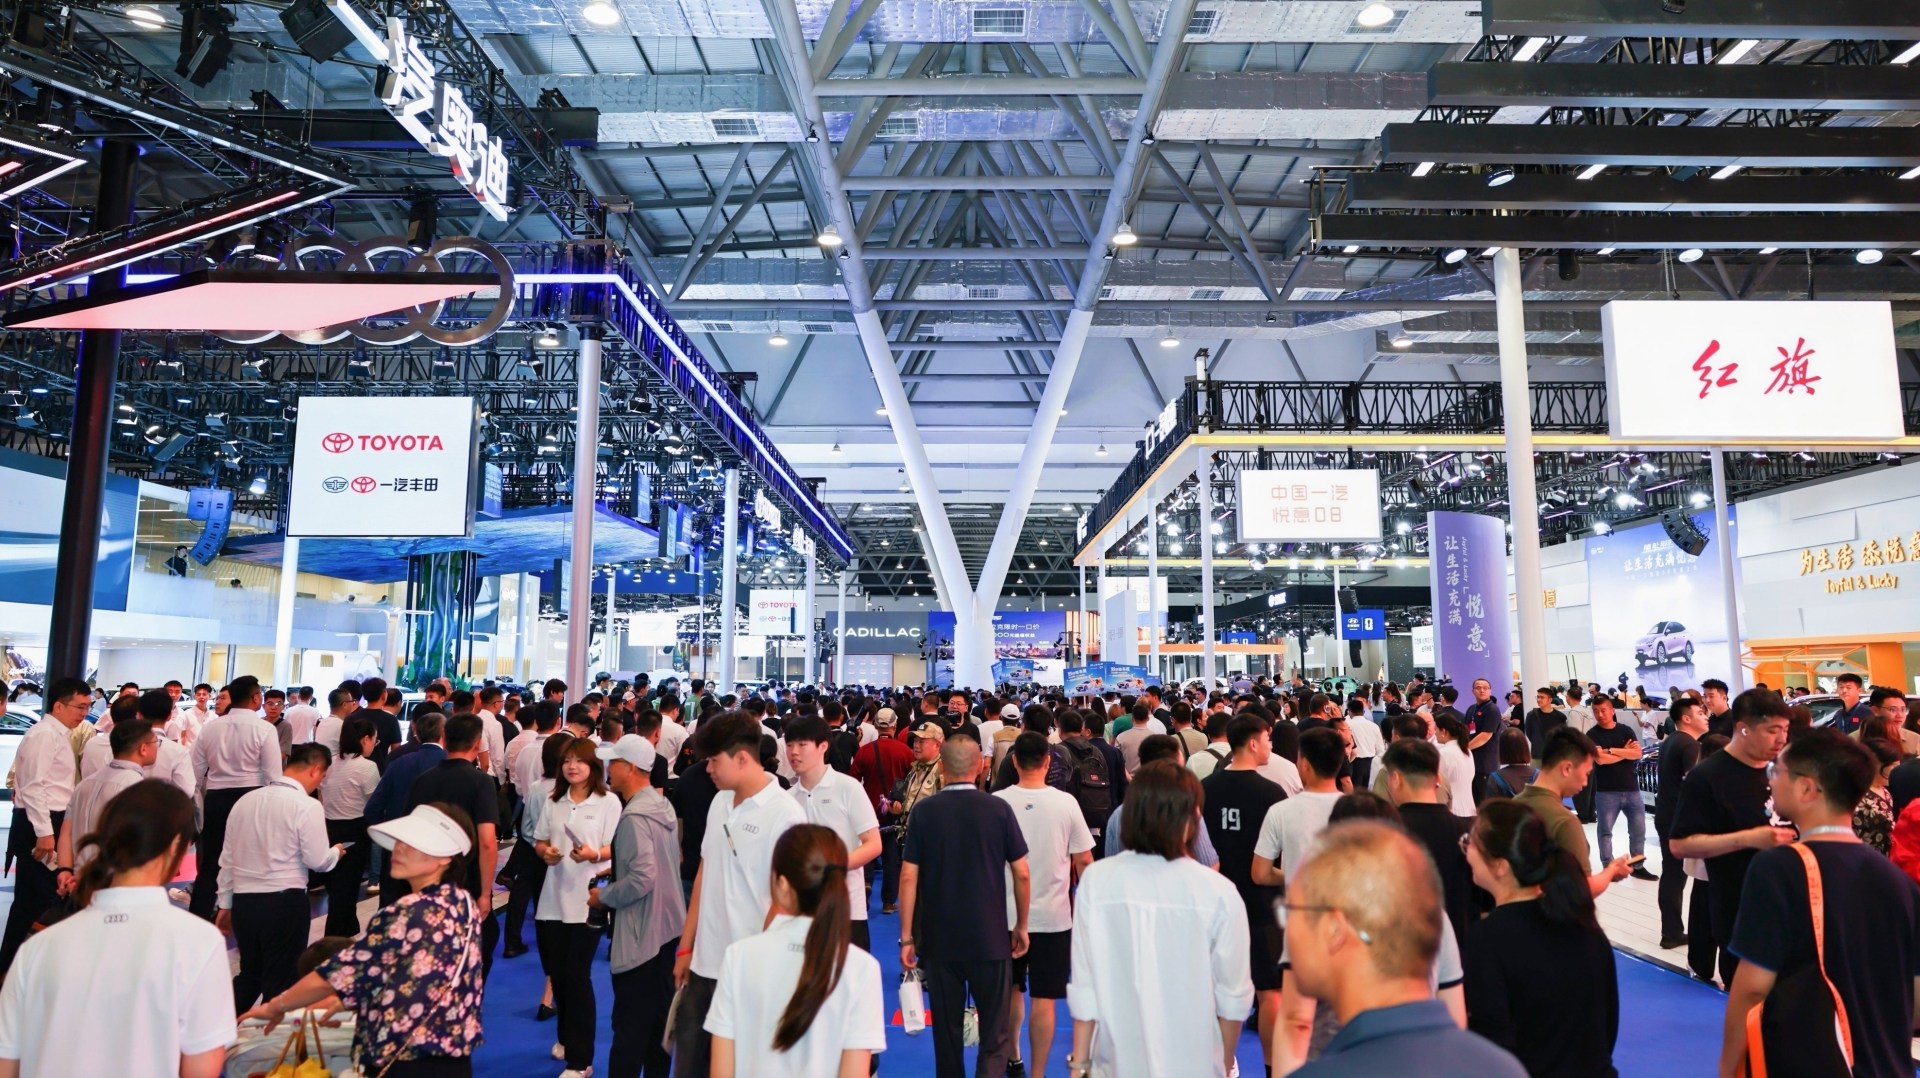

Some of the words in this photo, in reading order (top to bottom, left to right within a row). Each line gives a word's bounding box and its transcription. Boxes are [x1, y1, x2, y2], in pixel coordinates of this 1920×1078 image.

[1692, 337, 1822, 399] 红旗
[358, 435, 443, 450] TOYOTA
[380, 478, 438, 492] 一汽丰田
[1271, 484, 1349, 501] 中国一汽
[1444, 535, 1462, 626] 让生活充满
[1825, 577, 1854, 594] Joyful
[1857, 576, 1866, 590] &
[1868, 572, 1898, 589] Lucky
[1221, 807, 1241, 831] 19
